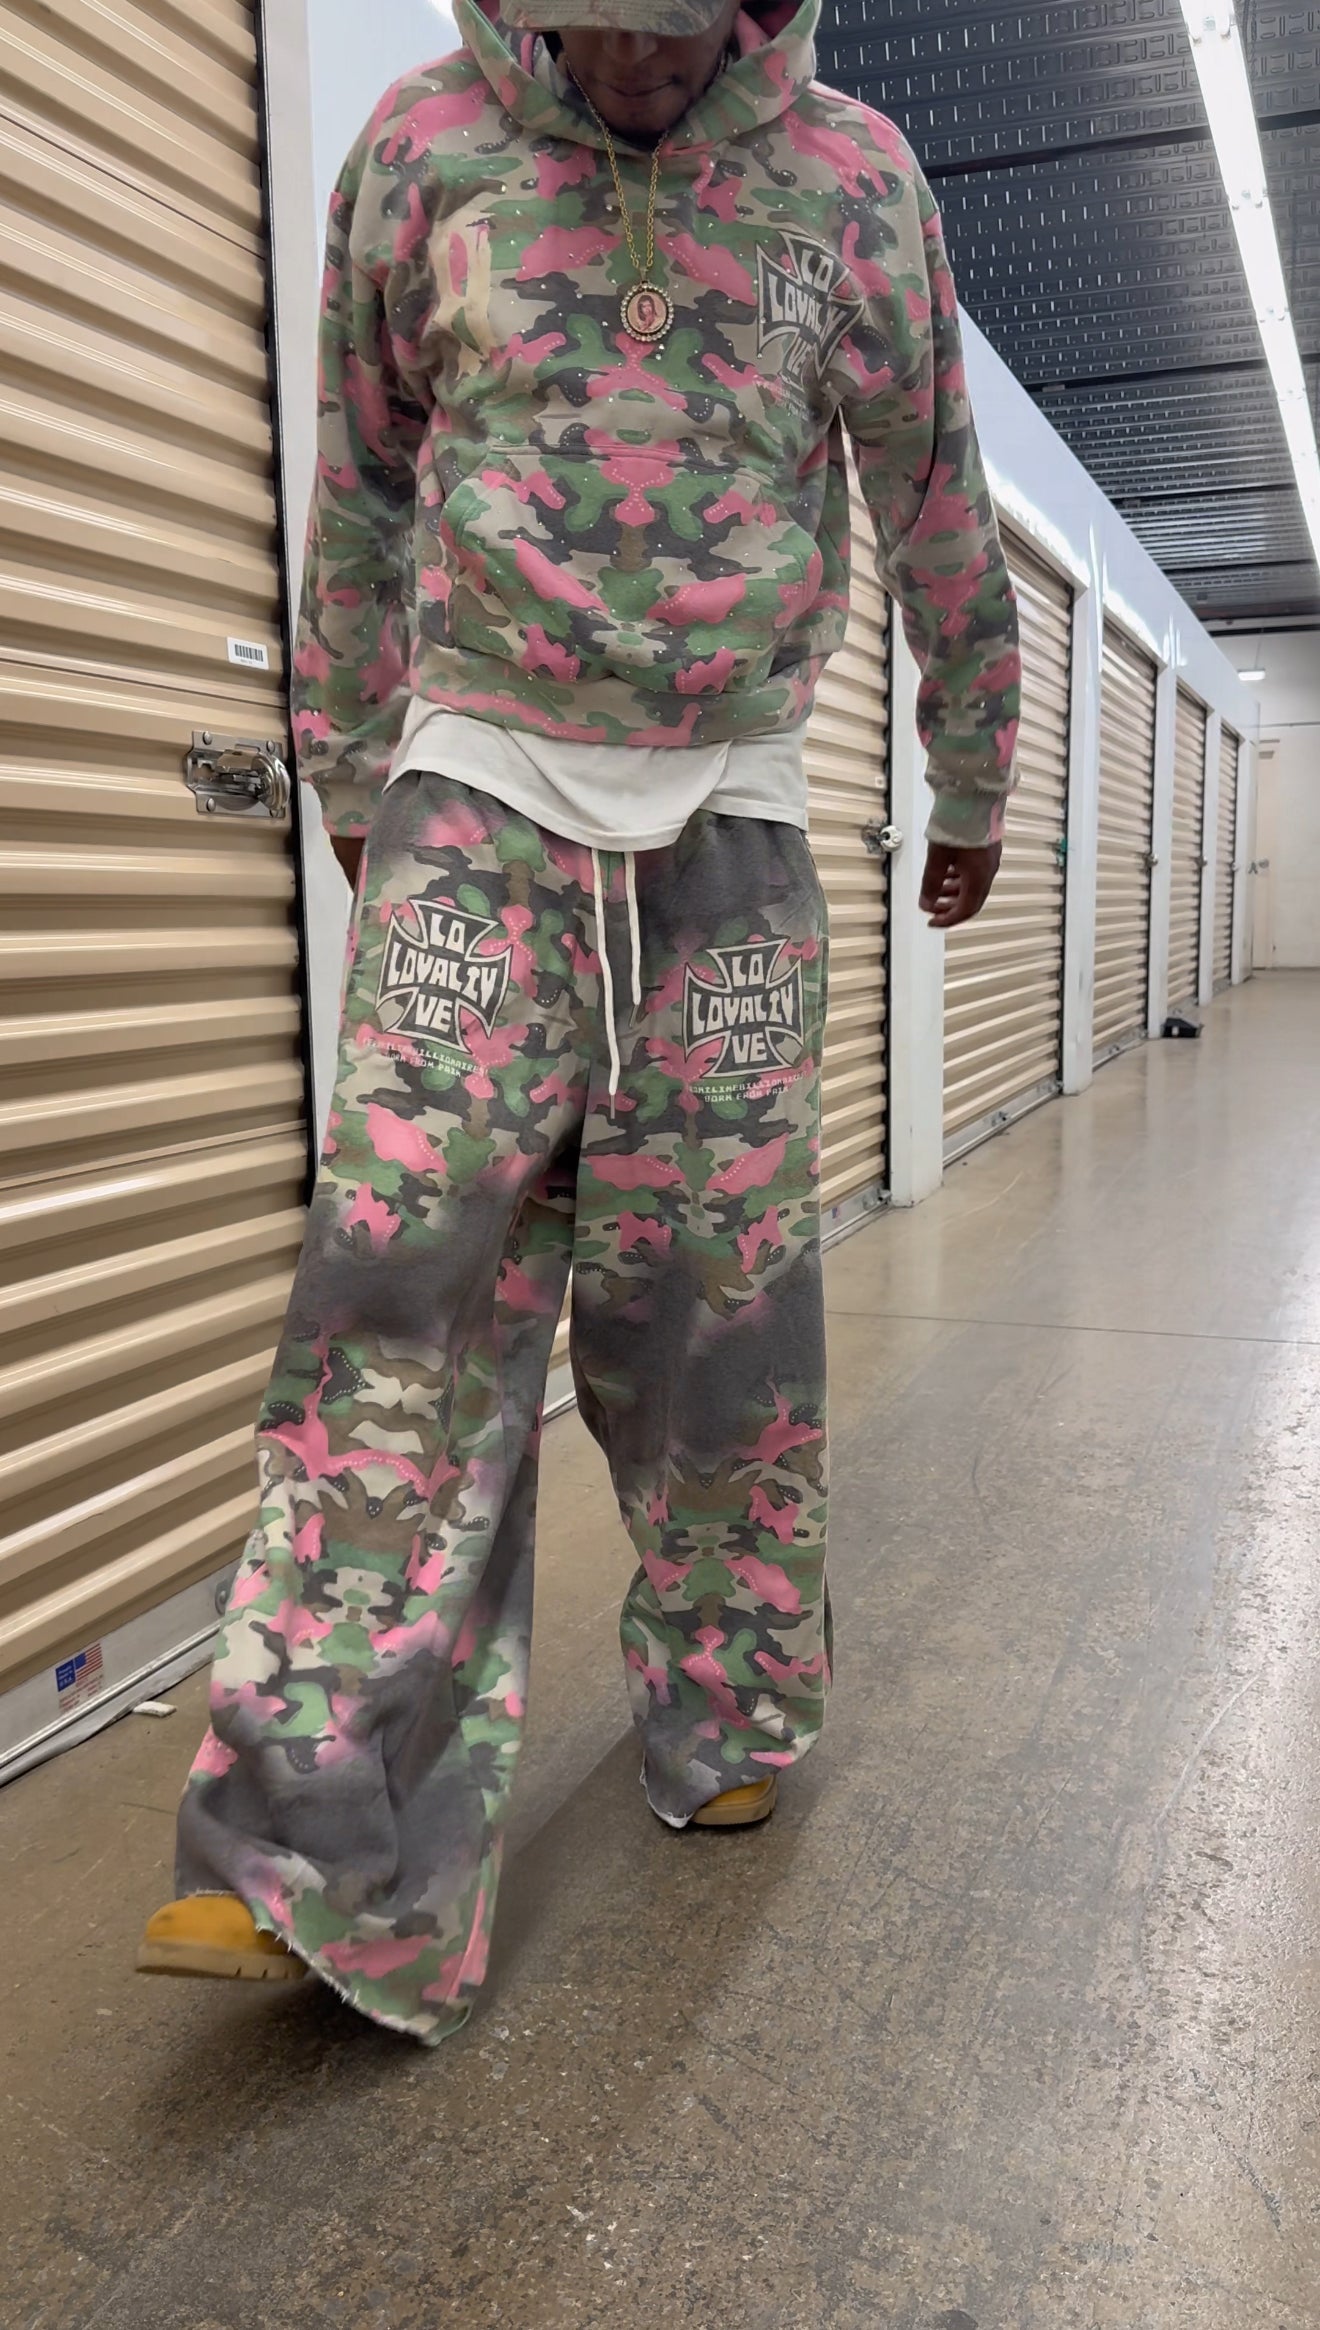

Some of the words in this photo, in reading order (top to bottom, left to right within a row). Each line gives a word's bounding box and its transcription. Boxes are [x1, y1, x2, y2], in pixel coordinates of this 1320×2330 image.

[801, 248, 834, 293] LO
[767, 272, 847, 347] LOYALY
[430, 912, 465, 954] LO
[387, 941, 498, 1010] LOYALTY
[732, 953, 764, 987] LO
[415, 994, 453, 1033] VE
[692, 983, 793, 1036] LOYALTY
[732, 1032, 767, 1064] VE
